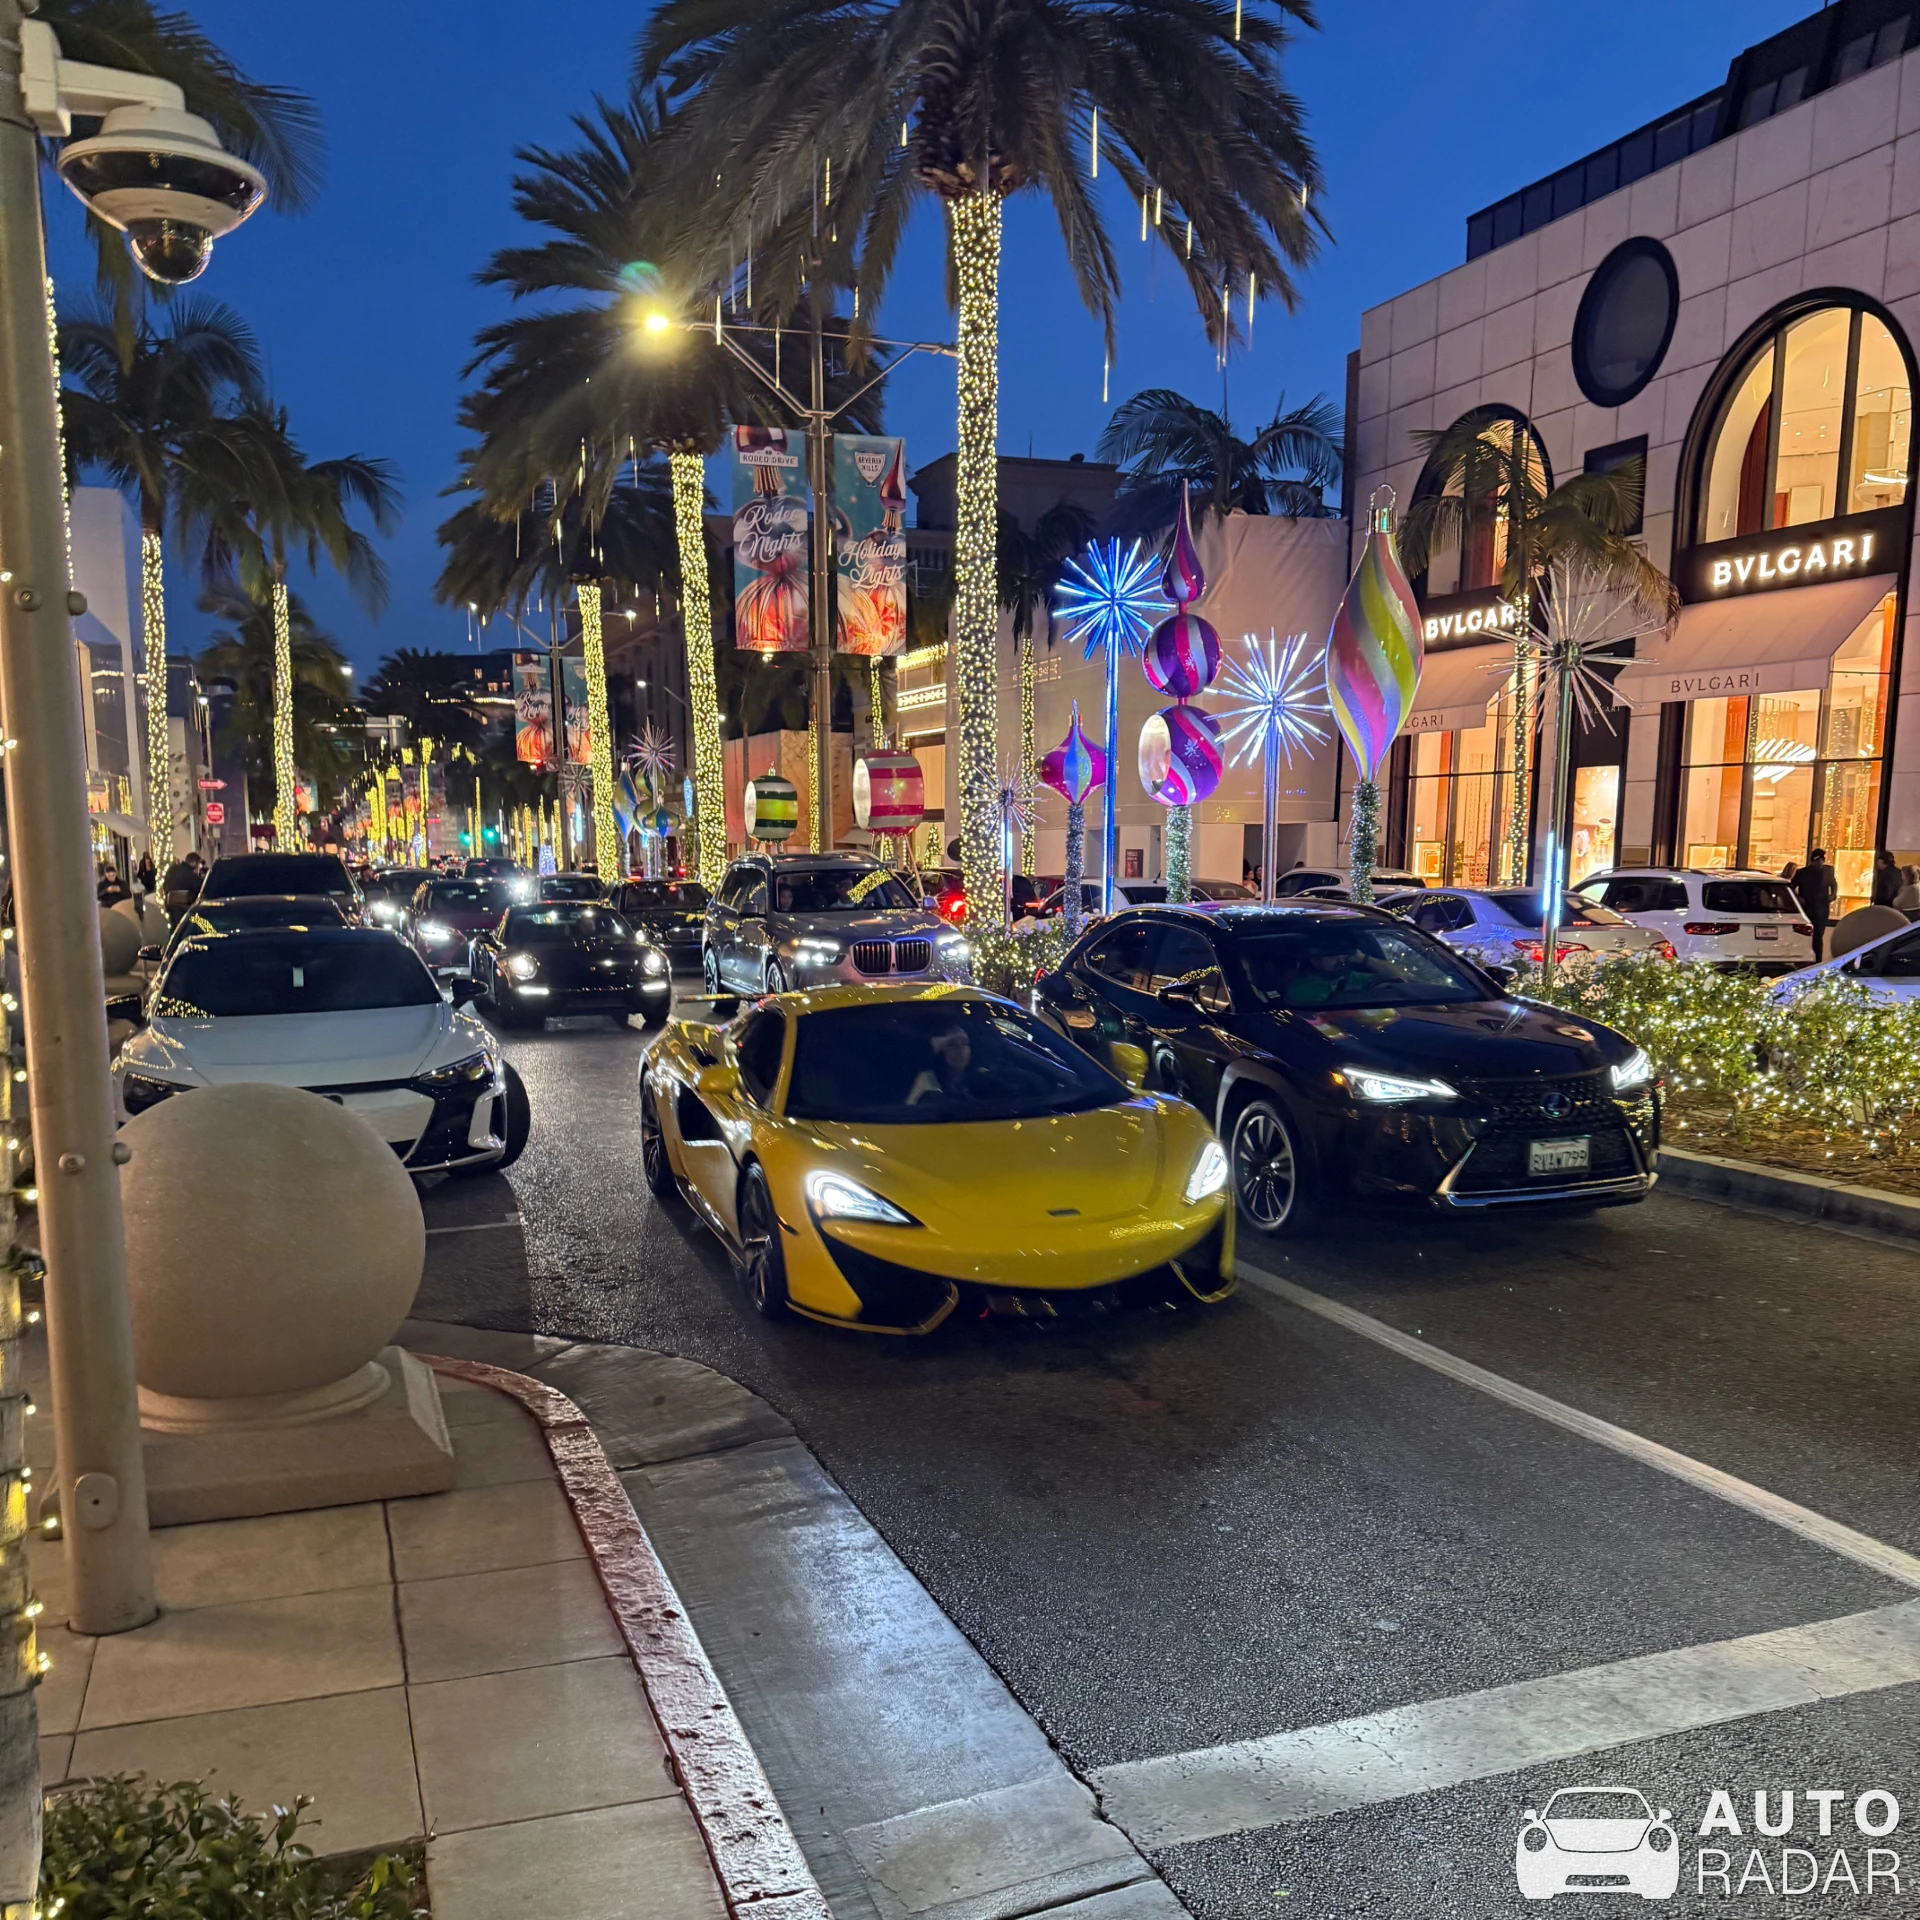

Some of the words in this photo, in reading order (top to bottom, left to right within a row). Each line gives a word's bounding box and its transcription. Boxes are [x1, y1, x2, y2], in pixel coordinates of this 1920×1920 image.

[742, 454, 769, 464] RODEO
[772, 456, 796, 465] DRIVE
[858, 456, 882, 464] BEVERLY
[744, 504, 797, 535] Rodeo
[739, 530, 803, 563] Nights
[838, 539, 902, 566] Holiday
[1712, 535, 1874, 586] BVLGARI
[850, 564, 905, 589] Lights
[1426, 604, 1518, 640] BVLGAR
[1670, 672, 1760, 694] BVLGARI
[1404, 714, 1444, 729] LGARI
